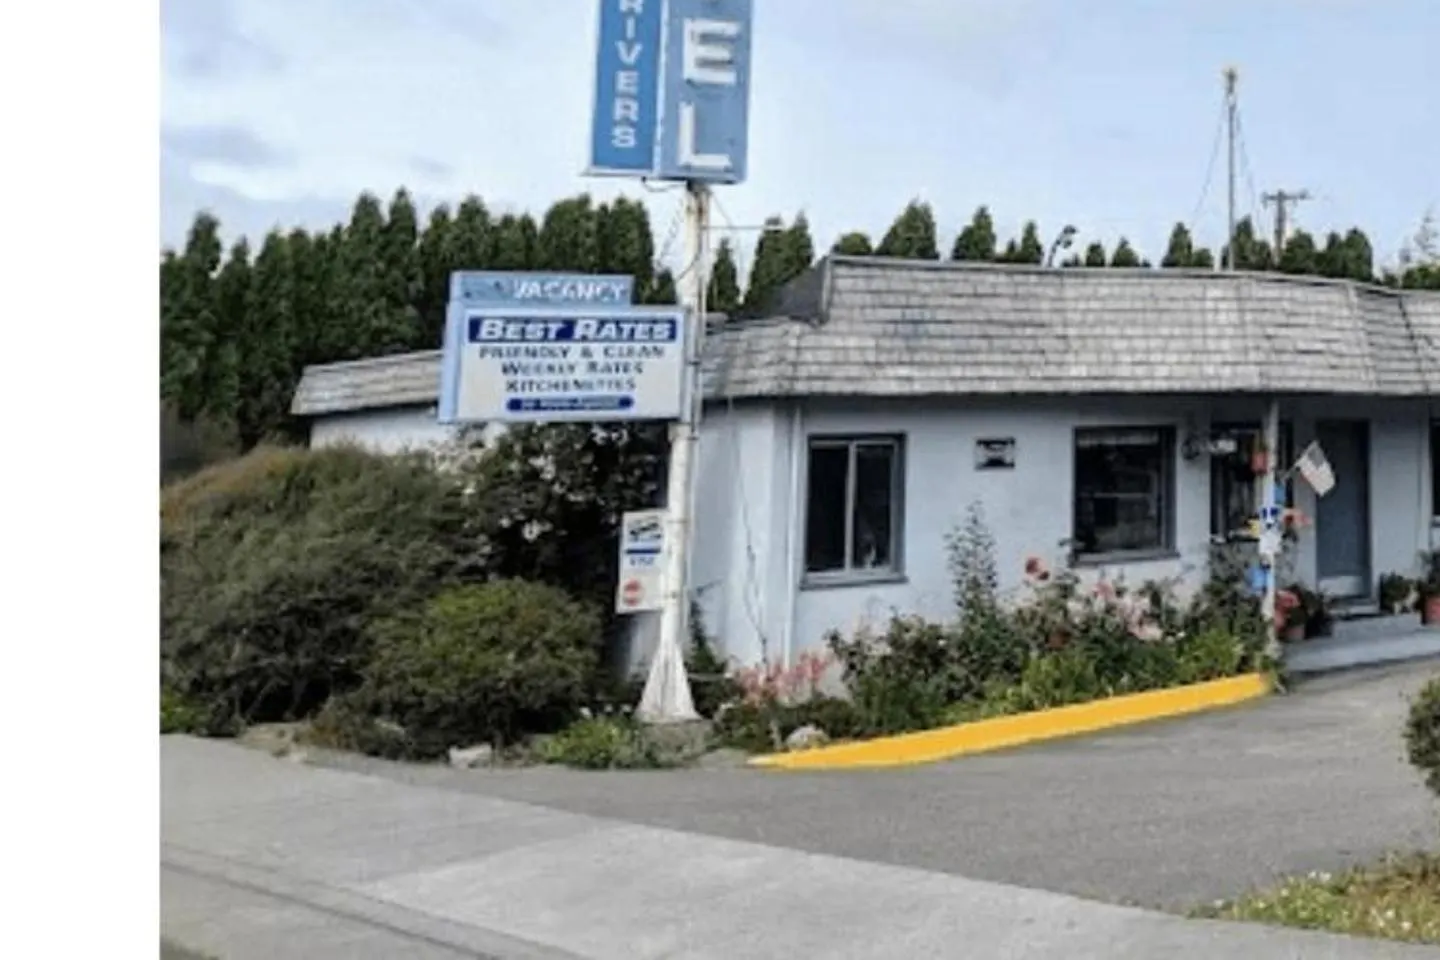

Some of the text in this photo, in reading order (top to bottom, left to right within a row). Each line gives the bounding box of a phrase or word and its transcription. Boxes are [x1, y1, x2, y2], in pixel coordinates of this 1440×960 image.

[514, 279, 625, 301] VACANCY
[478, 317, 672, 341] BEST RATES
[479, 345, 665, 359] FRIENDLY & CLEAN
[501, 360, 644, 375] WEEKLY RATES
